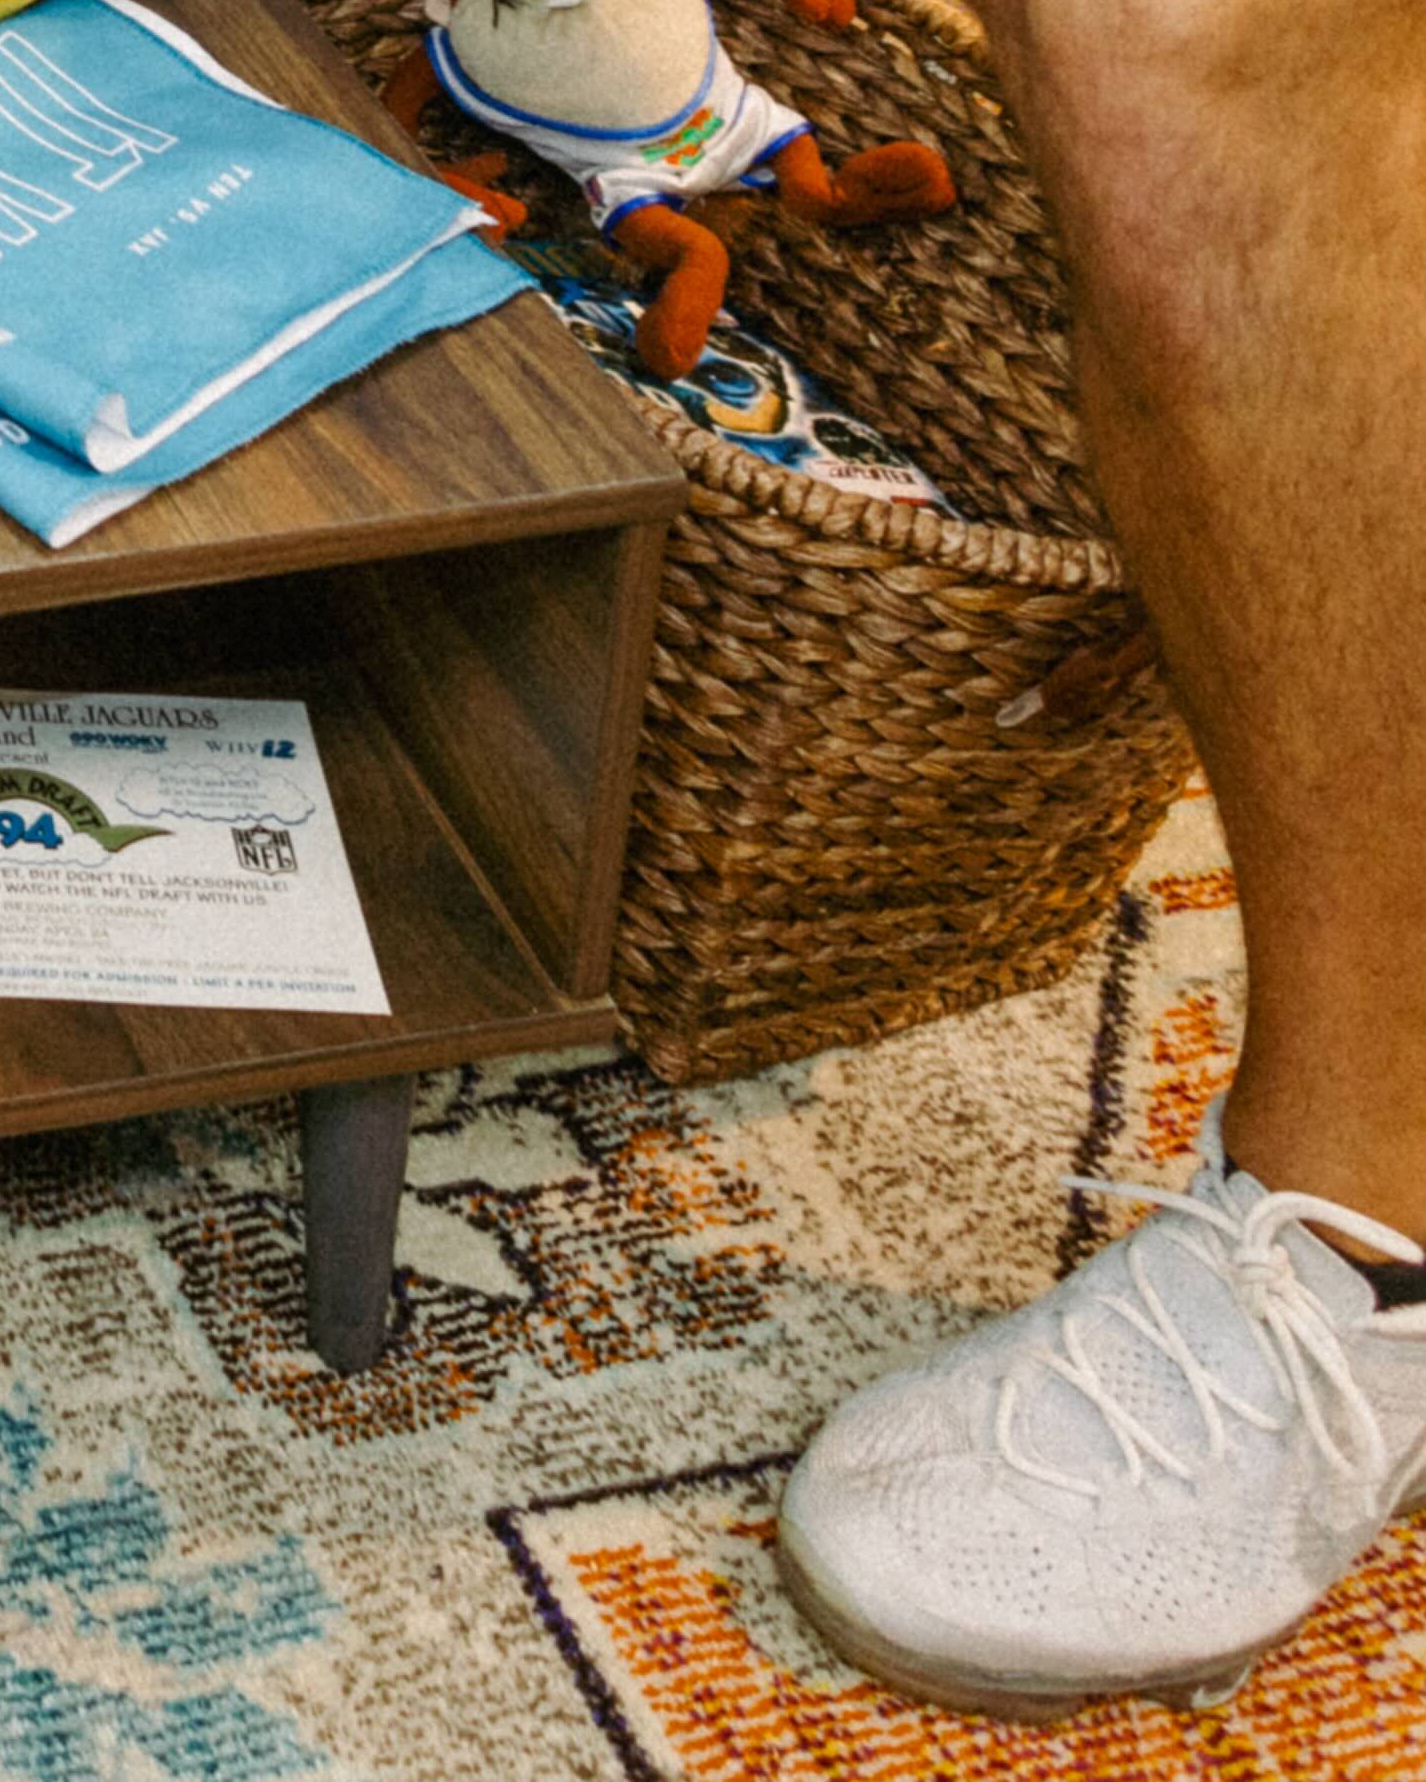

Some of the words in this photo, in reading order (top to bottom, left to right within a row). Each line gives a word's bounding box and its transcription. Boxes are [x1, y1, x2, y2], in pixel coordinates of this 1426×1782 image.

[81, 706, 220, 730] JAGUARS
[28, 775, 103, 829] DRAFT
[239, 845, 296, 870] NFL
[65, 885, 97, 898] THE
